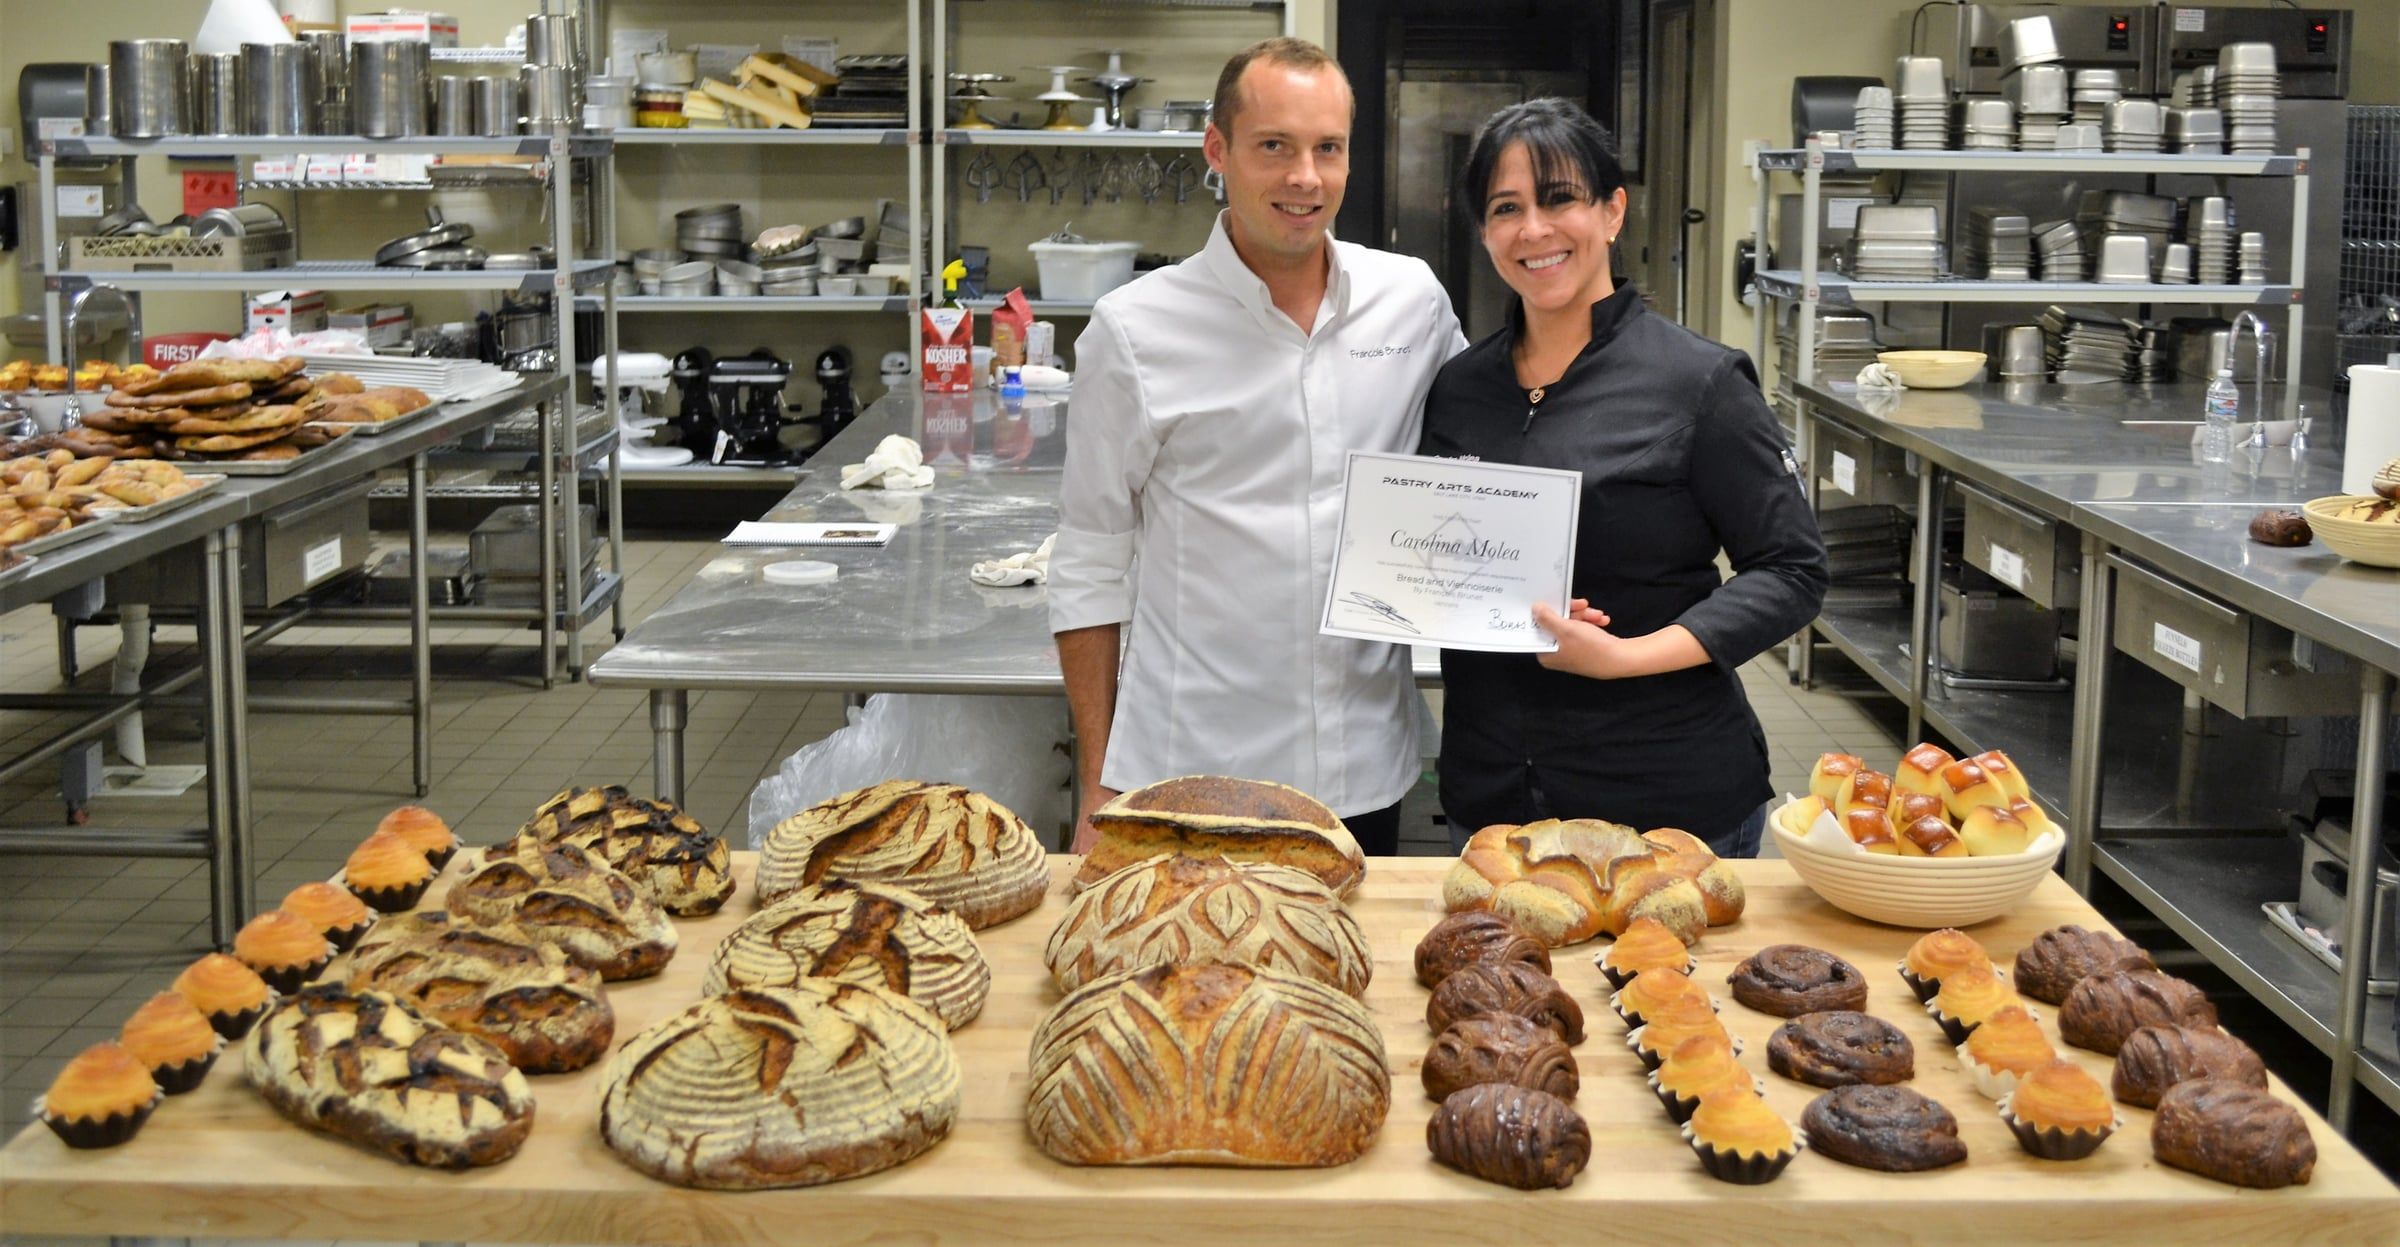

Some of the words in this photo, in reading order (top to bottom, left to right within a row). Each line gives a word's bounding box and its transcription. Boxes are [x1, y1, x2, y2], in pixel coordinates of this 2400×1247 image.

[154, 343, 199, 361] FIRST
[925, 348, 967, 364] KOSHER
[1382, 476, 1433, 488] PASTRY
[1436, 482, 1472, 493] ARTS
[1475, 486, 1539, 500] ACADEMY
[1390, 529, 1461, 554] Carolina
[1465, 538, 1521, 561] Molea
[1396, 573, 1424, 584] Bread
[1426, 577, 1444, 588] and
